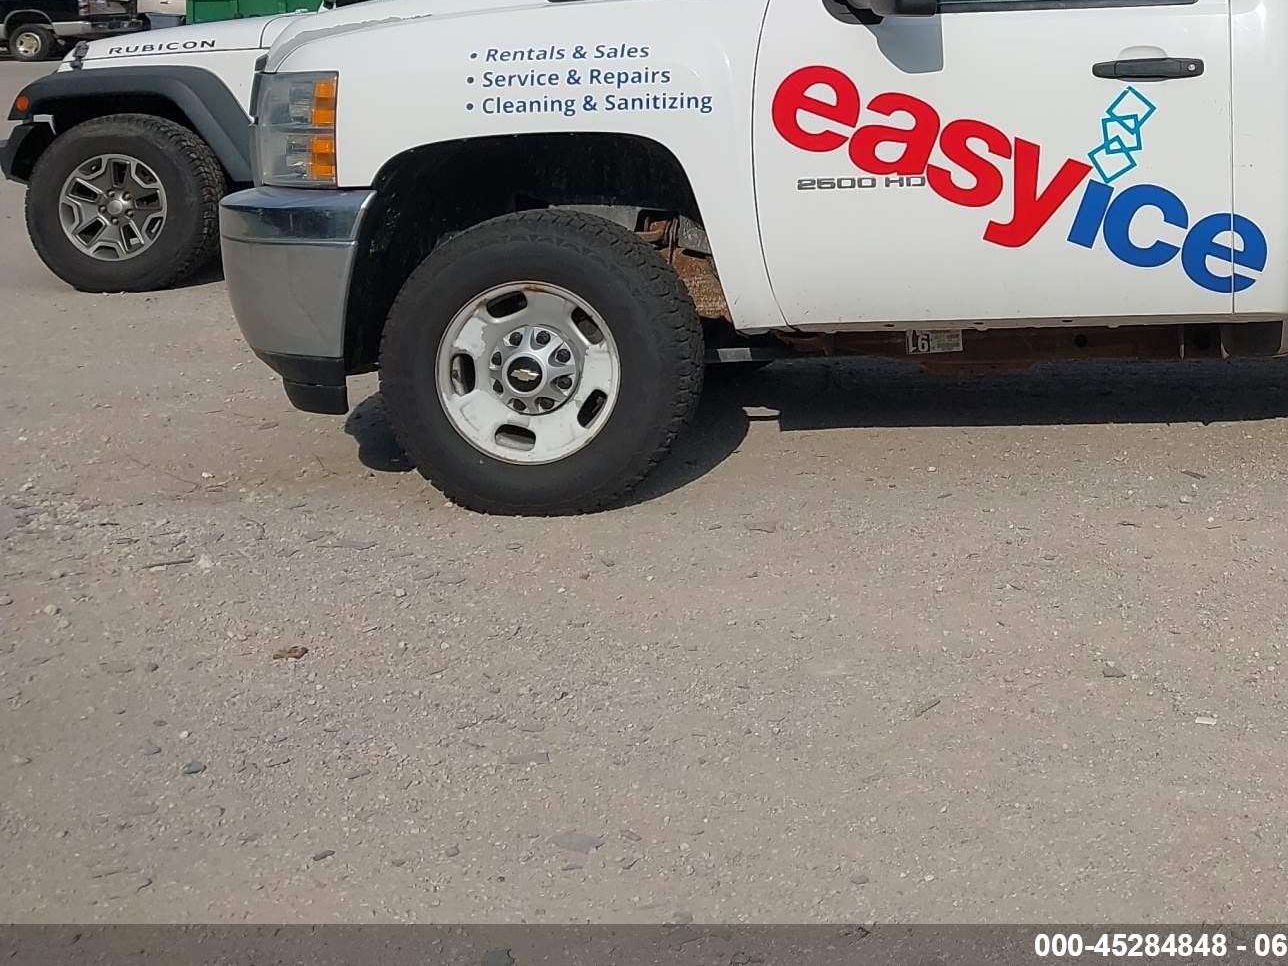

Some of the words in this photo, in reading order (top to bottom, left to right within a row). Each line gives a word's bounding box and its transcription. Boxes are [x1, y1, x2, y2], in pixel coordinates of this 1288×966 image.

[108, 39, 216, 55] RUBICON
[485, 45, 566, 62] Rentals
[572, 45, 588, 60] &
[593, 43, 650, 59] Sales
[482, 69, 560, 88] Service
[566, 69, 582, 86] &
[589, 66, 671, 89] Repairs
[482, 95, 576, 118] Cleaning
[582, 94, 598, 112] &
[604, 92, 713, 114] Sanitizing
[796, 177, 877, 191] 2500
[884, 176, 926, 188] HD
